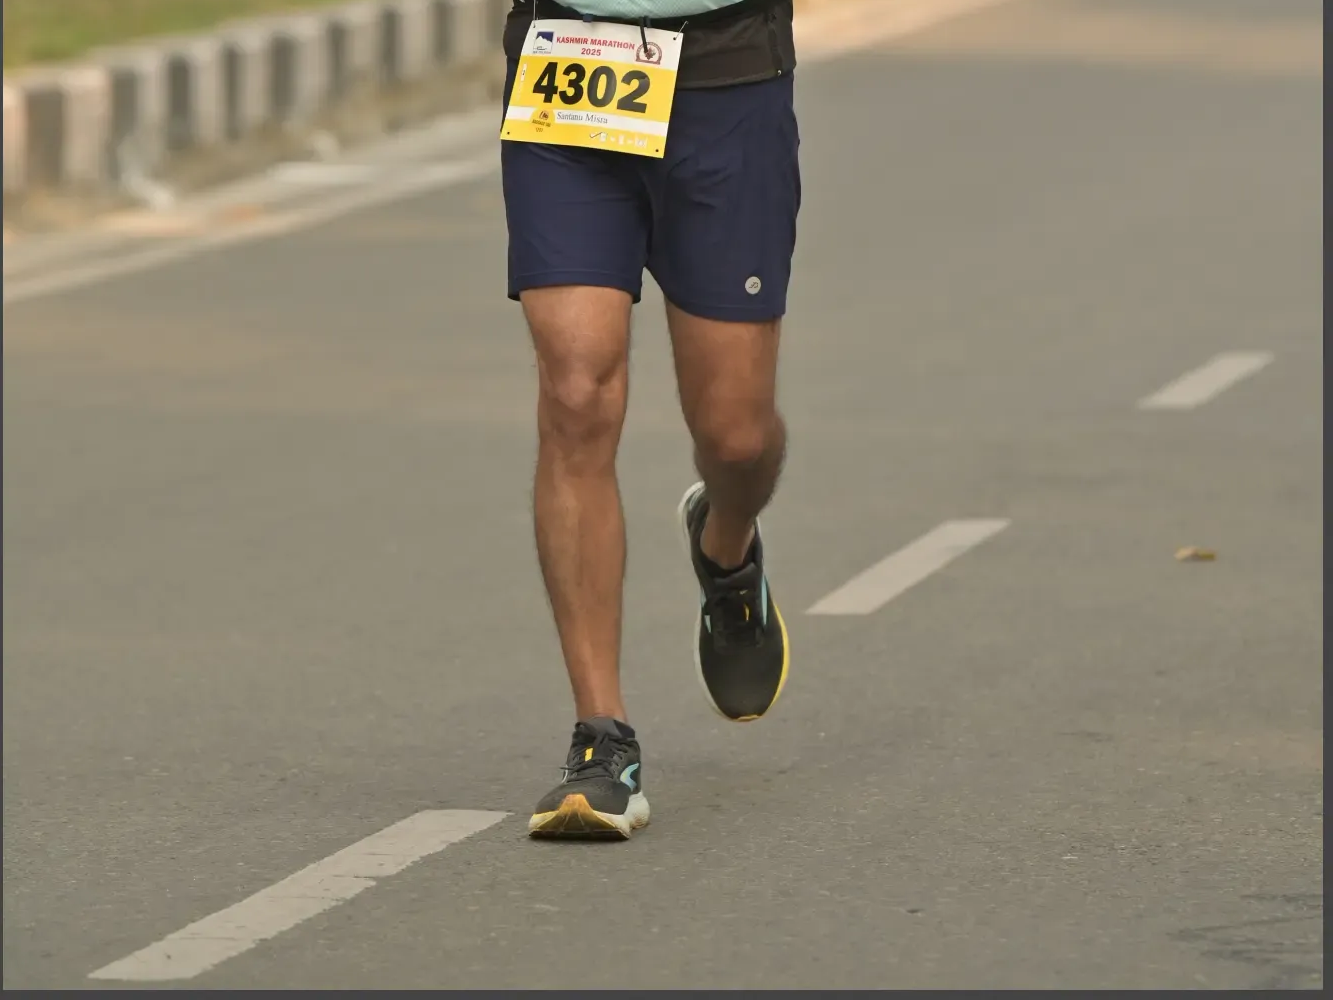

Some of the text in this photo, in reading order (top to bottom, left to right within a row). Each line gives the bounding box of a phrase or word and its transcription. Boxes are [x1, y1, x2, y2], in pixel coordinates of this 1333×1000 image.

[556, 36, 636, 50] KASHMIR MARATHON
[580, 47, 602, 57] 2025
[532, 61, 651, 114] 4302
[556, 111, 608, 125] Santanu Misra
